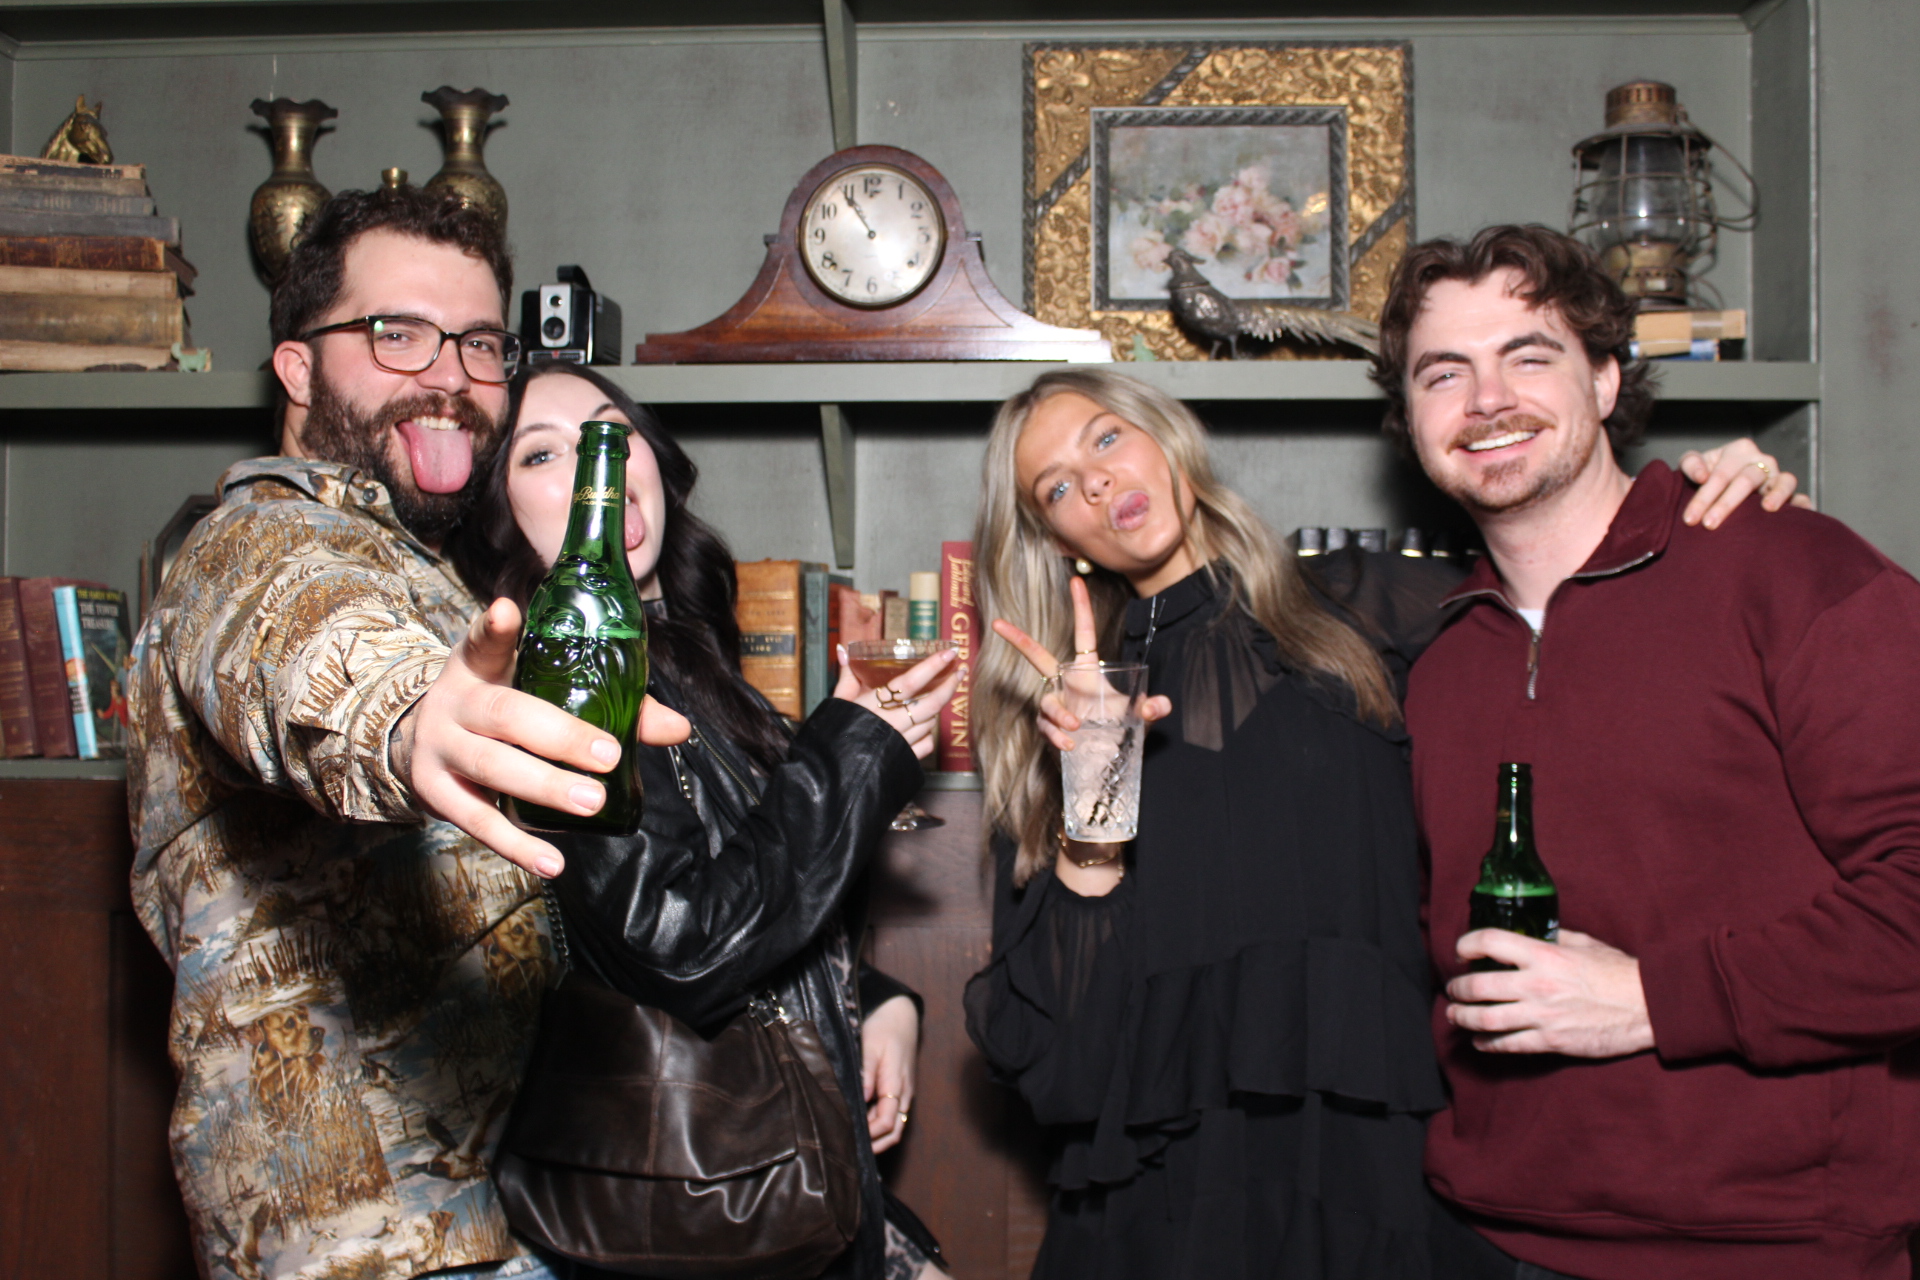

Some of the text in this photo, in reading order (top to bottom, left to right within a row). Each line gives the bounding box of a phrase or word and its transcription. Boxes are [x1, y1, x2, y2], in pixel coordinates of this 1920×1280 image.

[864, 177, 881, 198] 12
[898, 183, 903, 200] 1
[822, 203, 837, 220] 10
[911, 202, 923, 219] 2
[815, 228, 826, 245] 9
[822, 251, 834, 269] 8
[842, 268, 853, 287] 7
[867, 276, 878, 294] 6
[79, 602, 119, 617] THE TOWER
[81, 617, 115, 630] TREASURE
